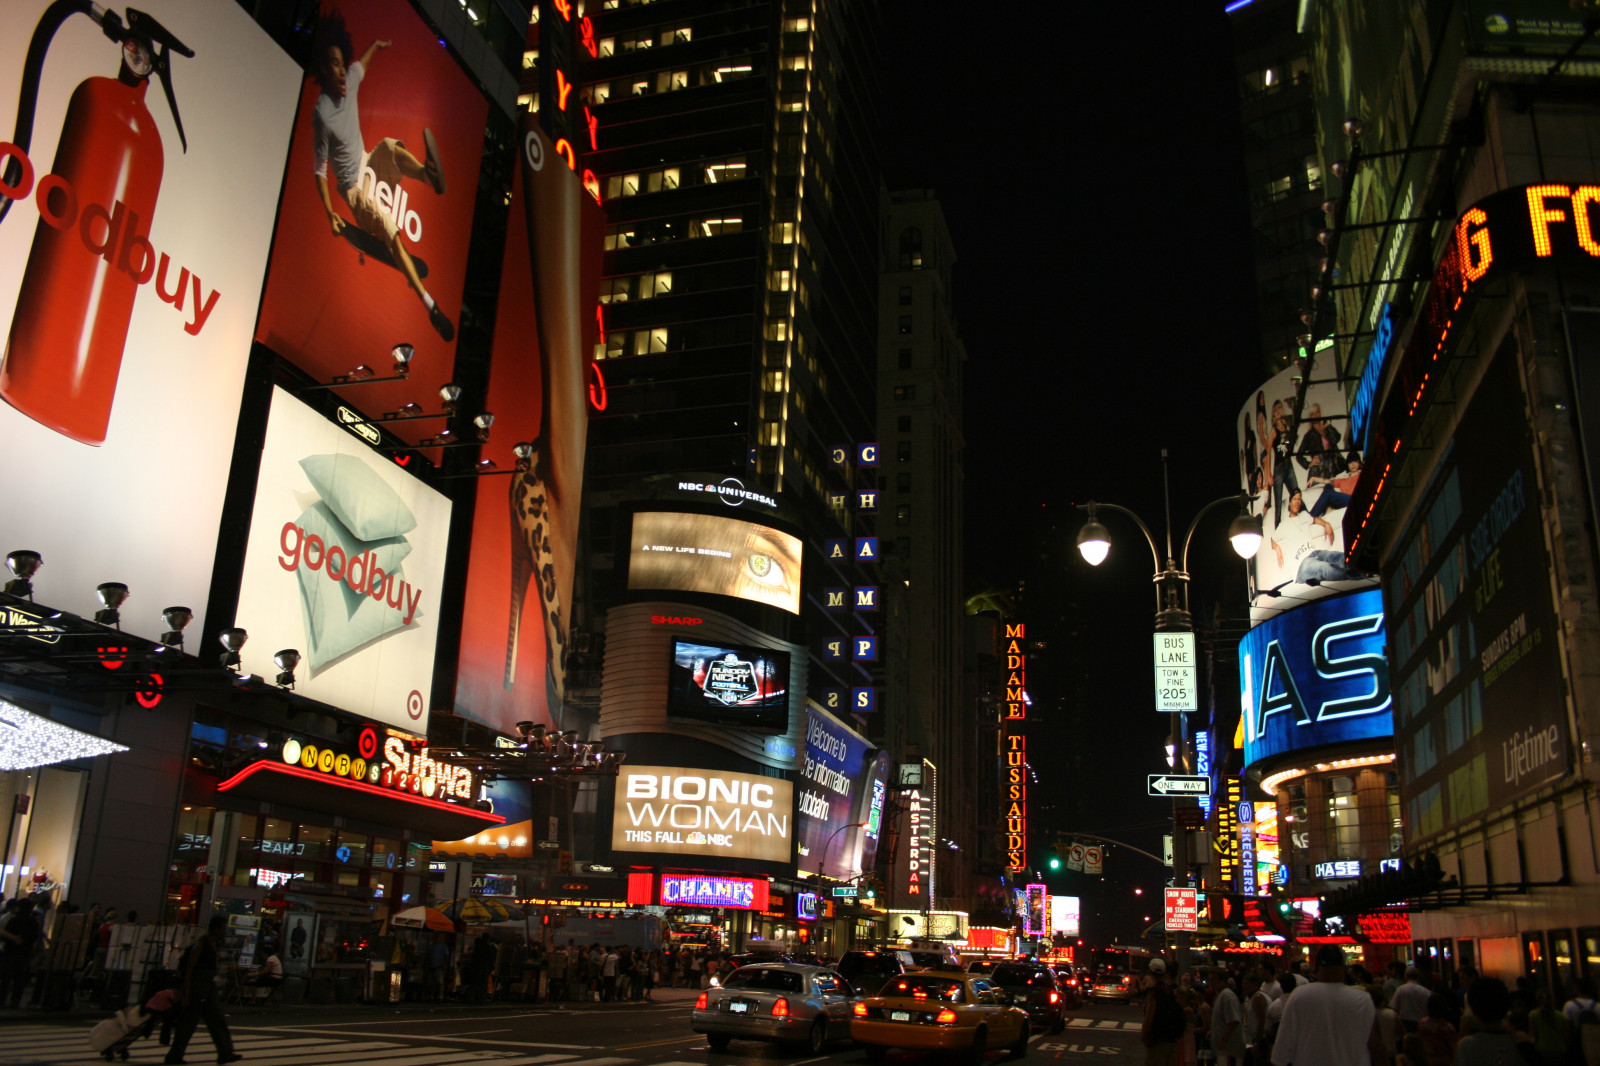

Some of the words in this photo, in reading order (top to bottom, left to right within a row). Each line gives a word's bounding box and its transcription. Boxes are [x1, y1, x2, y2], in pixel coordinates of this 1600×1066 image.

[357, 150, 422, 242] hello
[678, 482, 704, 491] NBC
[717, 486, 777, 507] UNIVERSAL
[675, 546, 696, 554] LIFE
[698, 548, 732, 558] BEGINS
[278, 521, 422, 625] goodbuy
[651, 615, 703, 626] SHARP
[1164, 638, 1185, 648] BUS
[1481, 628, 1511, 672] SUNDAYS
[1161, 652, 1188, 663] LANE
[712, 674, 748, 683] NIGHT
[1005, 624, 1022, 717] MADAME
[1162, 669, 1179, 677] TOW
[1182, 669, 1188, 677] &
[711, 681, 749, 690] FOOTBALL
[806, 716, 839, 759] Welcome
[839, 738, 847, 762] to
[1195, 731, 1208, 751] NEW
[1502, 724, 1559, 787] Lifetime
[307, 750, 315, 764] N
[323, 754, 332, 768] Q
[340, 758, 348, 772] R
[354, 764, 366, 779] W
[370, 765, 379, 780] S
[400, 774, 407, 788] 2
[413, 777, 421, 791] 3
[812, 757, 850, 797] information
[627, 774, 774, 809] BIONIC
[1158, 781, 1175, 790] ONE
[1183, 782, 1201, 790] WAY
[626, 802, 787, 838] WOMAN
[625, 830, 652, 842] THIS
[655, 832, 684, 844] FALL
[707, 833, 733, 847] NBC
[909, 790, 920, 895] AMSTERDAM
[1220, 858, 1232, 881] NEW
[1241, 826, 1255, 896] SKECHERS
[664, 880, 754, 904] CHAMPS
[917, 926, 952, 935] POPPINS
[922, 917, 947, 926] MARY
[1037, 1043, 1122, 1055] BUS
